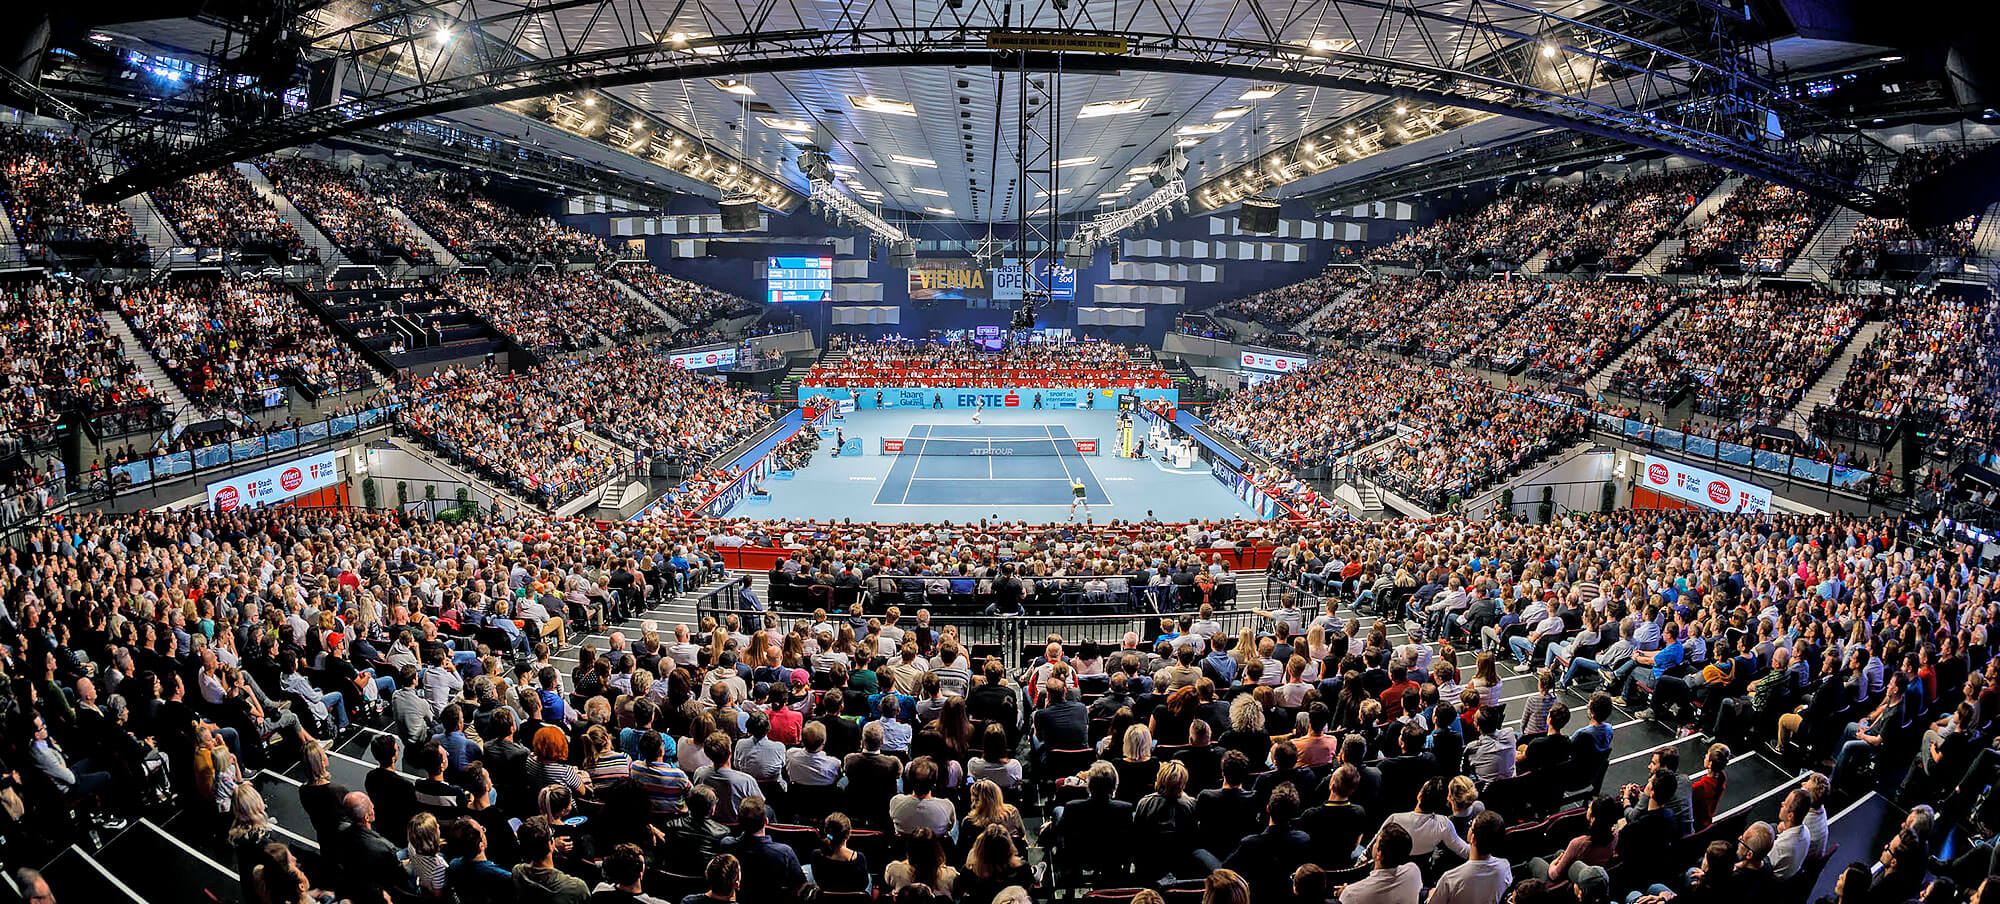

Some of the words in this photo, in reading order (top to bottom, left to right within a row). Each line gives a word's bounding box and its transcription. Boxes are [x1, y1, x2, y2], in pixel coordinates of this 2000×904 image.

[920, 269, 984, 289] VIENNA
[997, 273, 1031, 288] OPEN
[957, 394, 1003, 407] ERSTE
[320, 461, 333, 470] Stadt
[1651, 465, 1667, 477] Wien
[282, 471, 299, 481] Wien
[320, 469, 334, 478] Wien
[258, 478, 272, 488] Stadt
[1686, 475, 1700, 486] Stadt
[258, 487, 274, 497] Wien
[1685, 483, 1700, 494] Wien
[1710, 483, 1729, 495] Wien
[1751, 495, 1766, 507] Stadt
